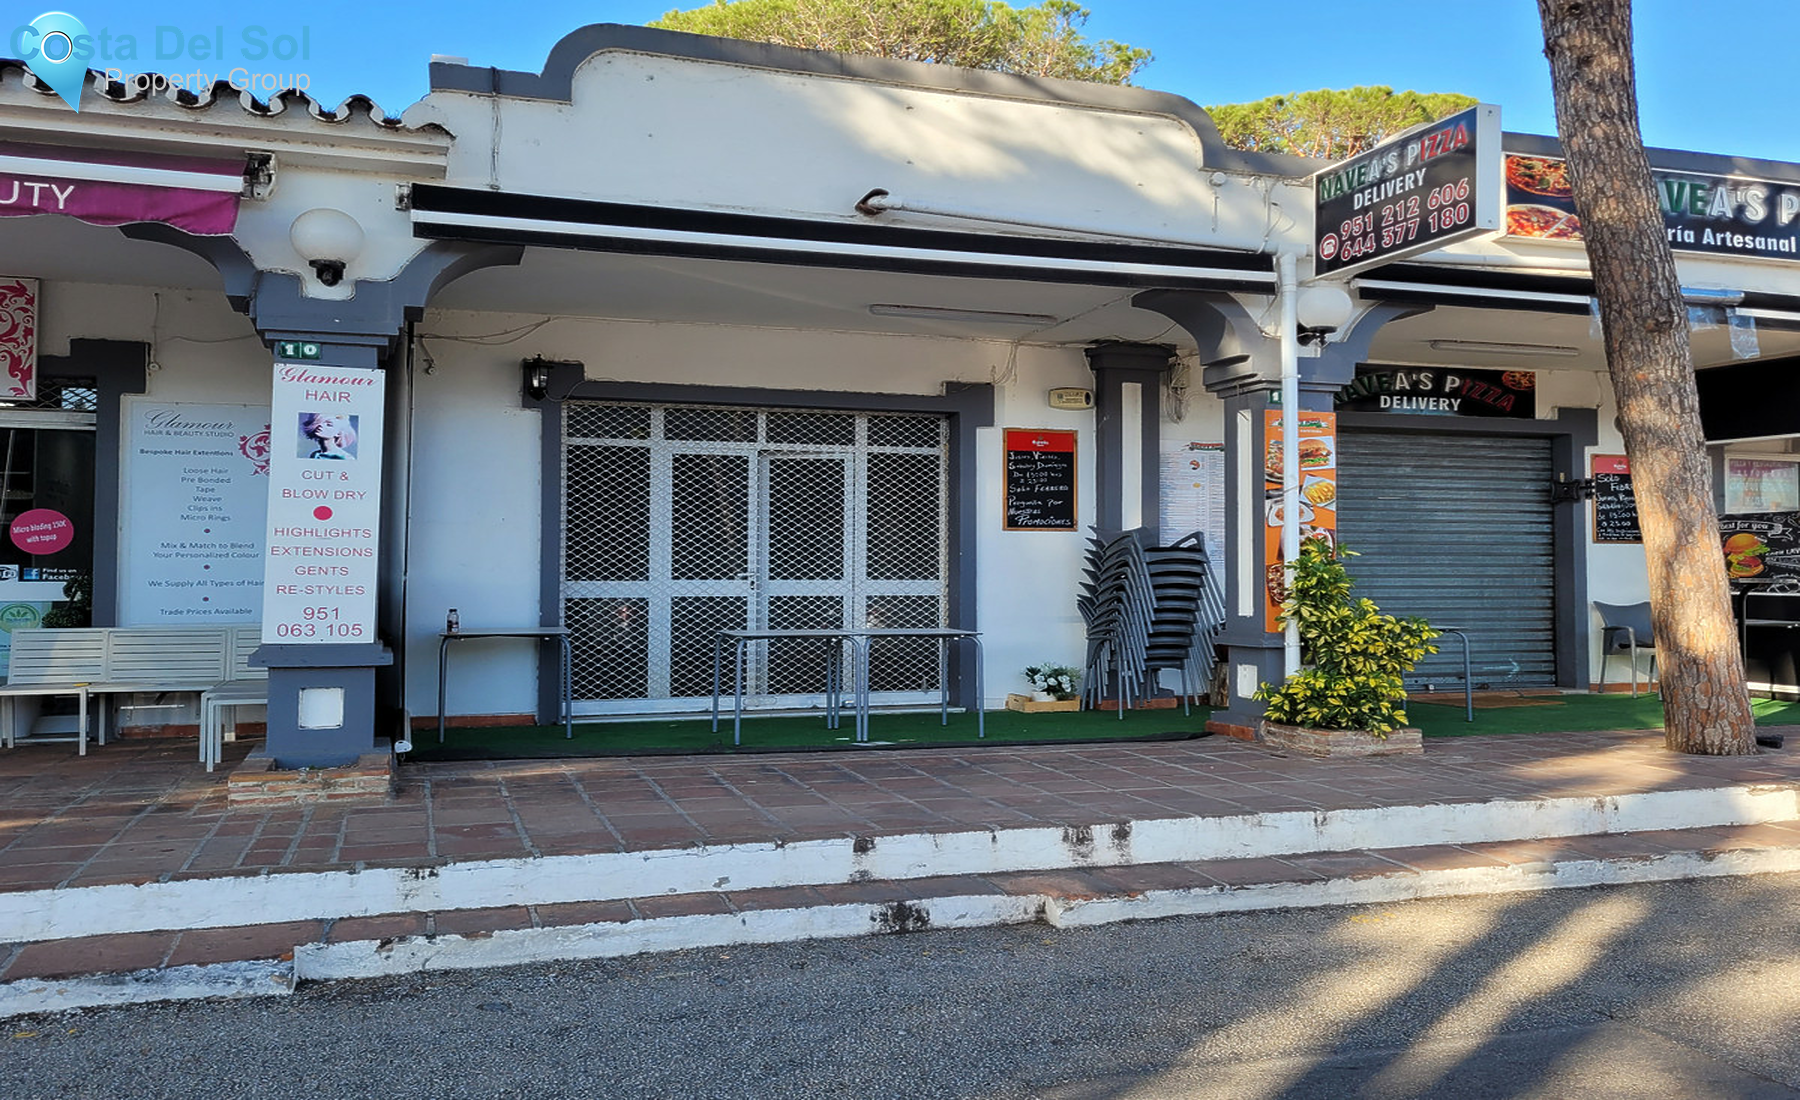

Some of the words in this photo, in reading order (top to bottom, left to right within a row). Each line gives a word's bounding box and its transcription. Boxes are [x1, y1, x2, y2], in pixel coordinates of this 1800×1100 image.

[1320, 151, 1399, 202] NAVEA'S
[1407, 124, 1469, 167] PIZZA
[1354, 168, 1427, 210] DELIVERY
[1341, 212, 1374, 240] 951
[1381, 196, 1420, 226] 212
[1427, 177, 1470, 210] 606
[1341, 233, 1376, 261] 644
[1382, 218, 1420, 248] 377
[1428, 203, 1470, 233] 180
[1702, 228, 1796, 253] Artesanal
[284, 343, 318, 356] 10
[278, 367, 376, 387] Glamour
[305, 390, 351, 403] HAIR
[1444, 376, 1516, 412] PIZZA
[1380, 395, 1462, 412] DELIVERY
[144, 409, 235, 430] Glamour
[139, 448, 173, 456] Bespoke
[301, 470, 334, 480] CUT
[339, 471, 349, 481] &
[195, 486, 216, 494] Tape
[281, 488, 329, 499] BLOW
[333, 490, 367, 500] DRY
[187, 504, 209, 512] Clips
[207, 514, 231, 522] Rings
[273, 527, 372, 538] HIGHLIGHTS
[270, 546, 373, 557] EXTENSIONS
[294, 565, 349, 576] GENTS
[164, 580, 195, 588] Supply
[276, 585, 366, 595] RE-STYLES
[303, 606, 339, 620] 951
[276, 623, 316, 637] 063
[326, 623, 363, 637] 105
